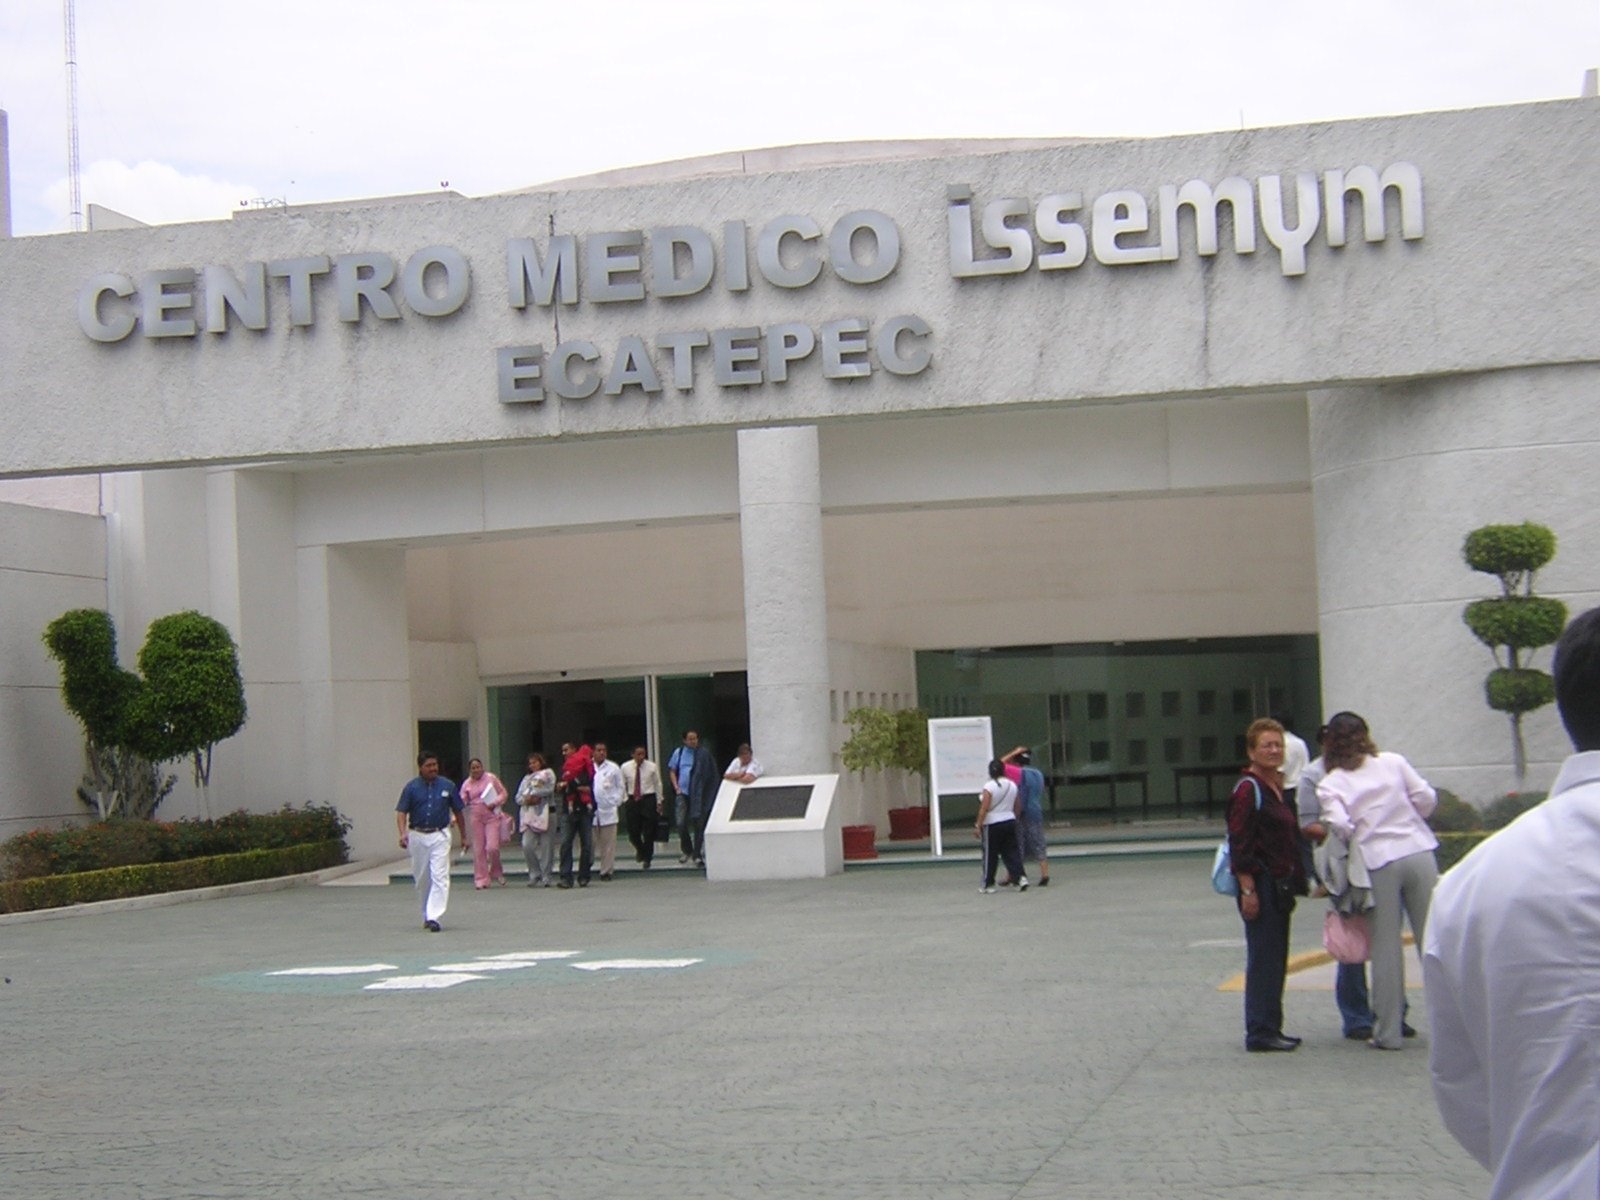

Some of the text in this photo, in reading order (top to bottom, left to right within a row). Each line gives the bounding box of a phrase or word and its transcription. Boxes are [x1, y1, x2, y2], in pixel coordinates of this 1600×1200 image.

[77, 244, 472, 342] CENTRO
[507, 209, 901, 308] MEDICO
[498, 315, 933, 404] ECATEPEC
